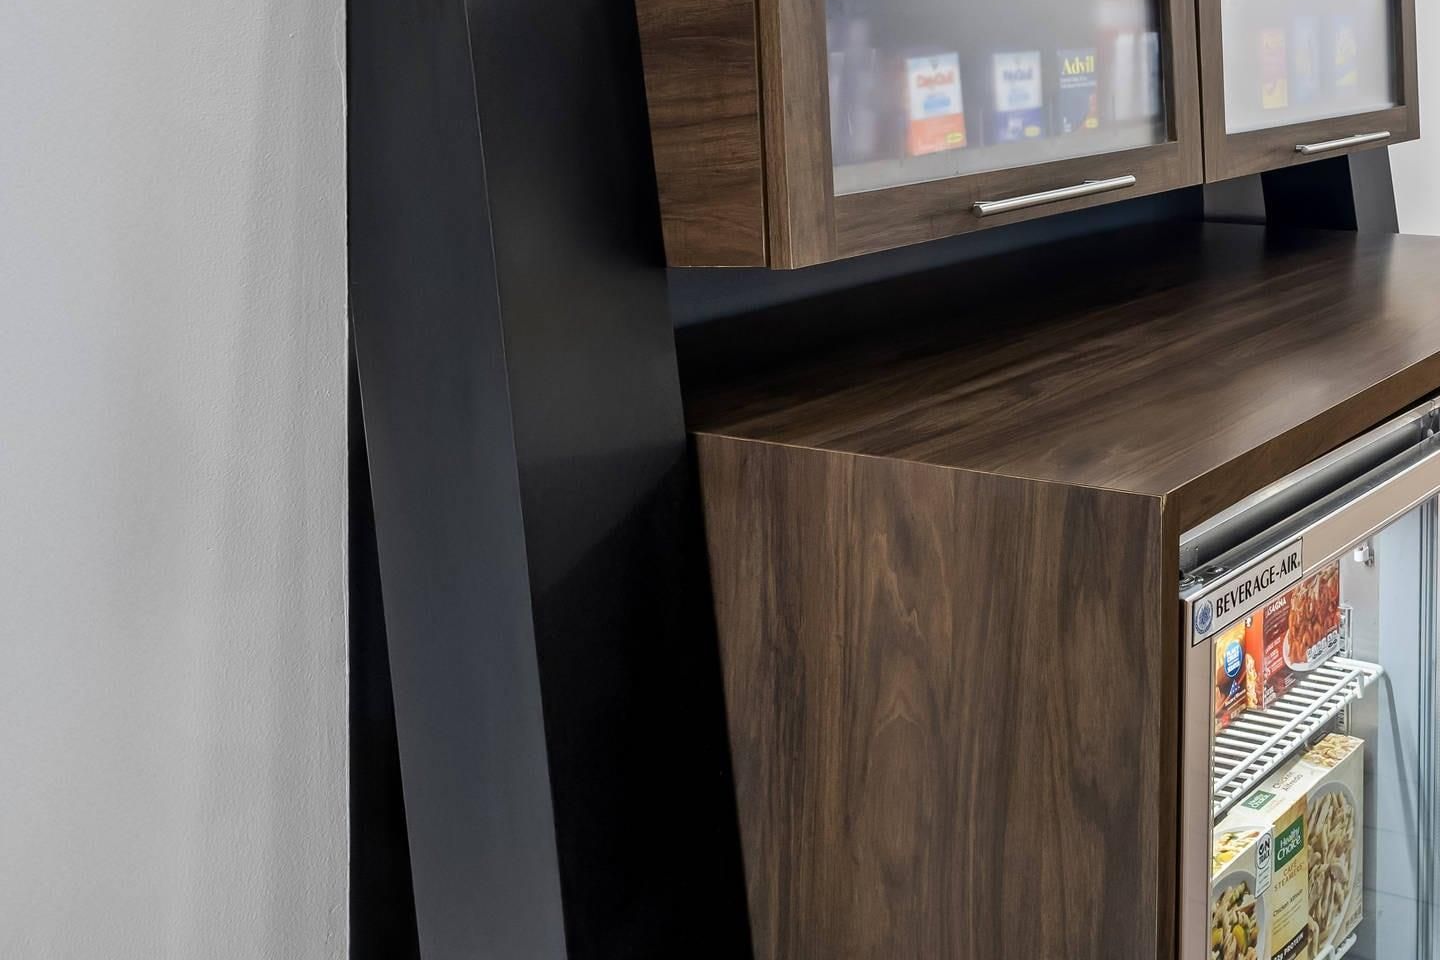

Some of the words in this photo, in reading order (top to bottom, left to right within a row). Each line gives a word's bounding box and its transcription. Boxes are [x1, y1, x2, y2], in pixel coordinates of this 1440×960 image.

[1062, 55, 1095, 75] Advil
[1215, 551, 1299, 619] BEVERAGE-AIR
[1277, 835, 1301, 861] Choice
